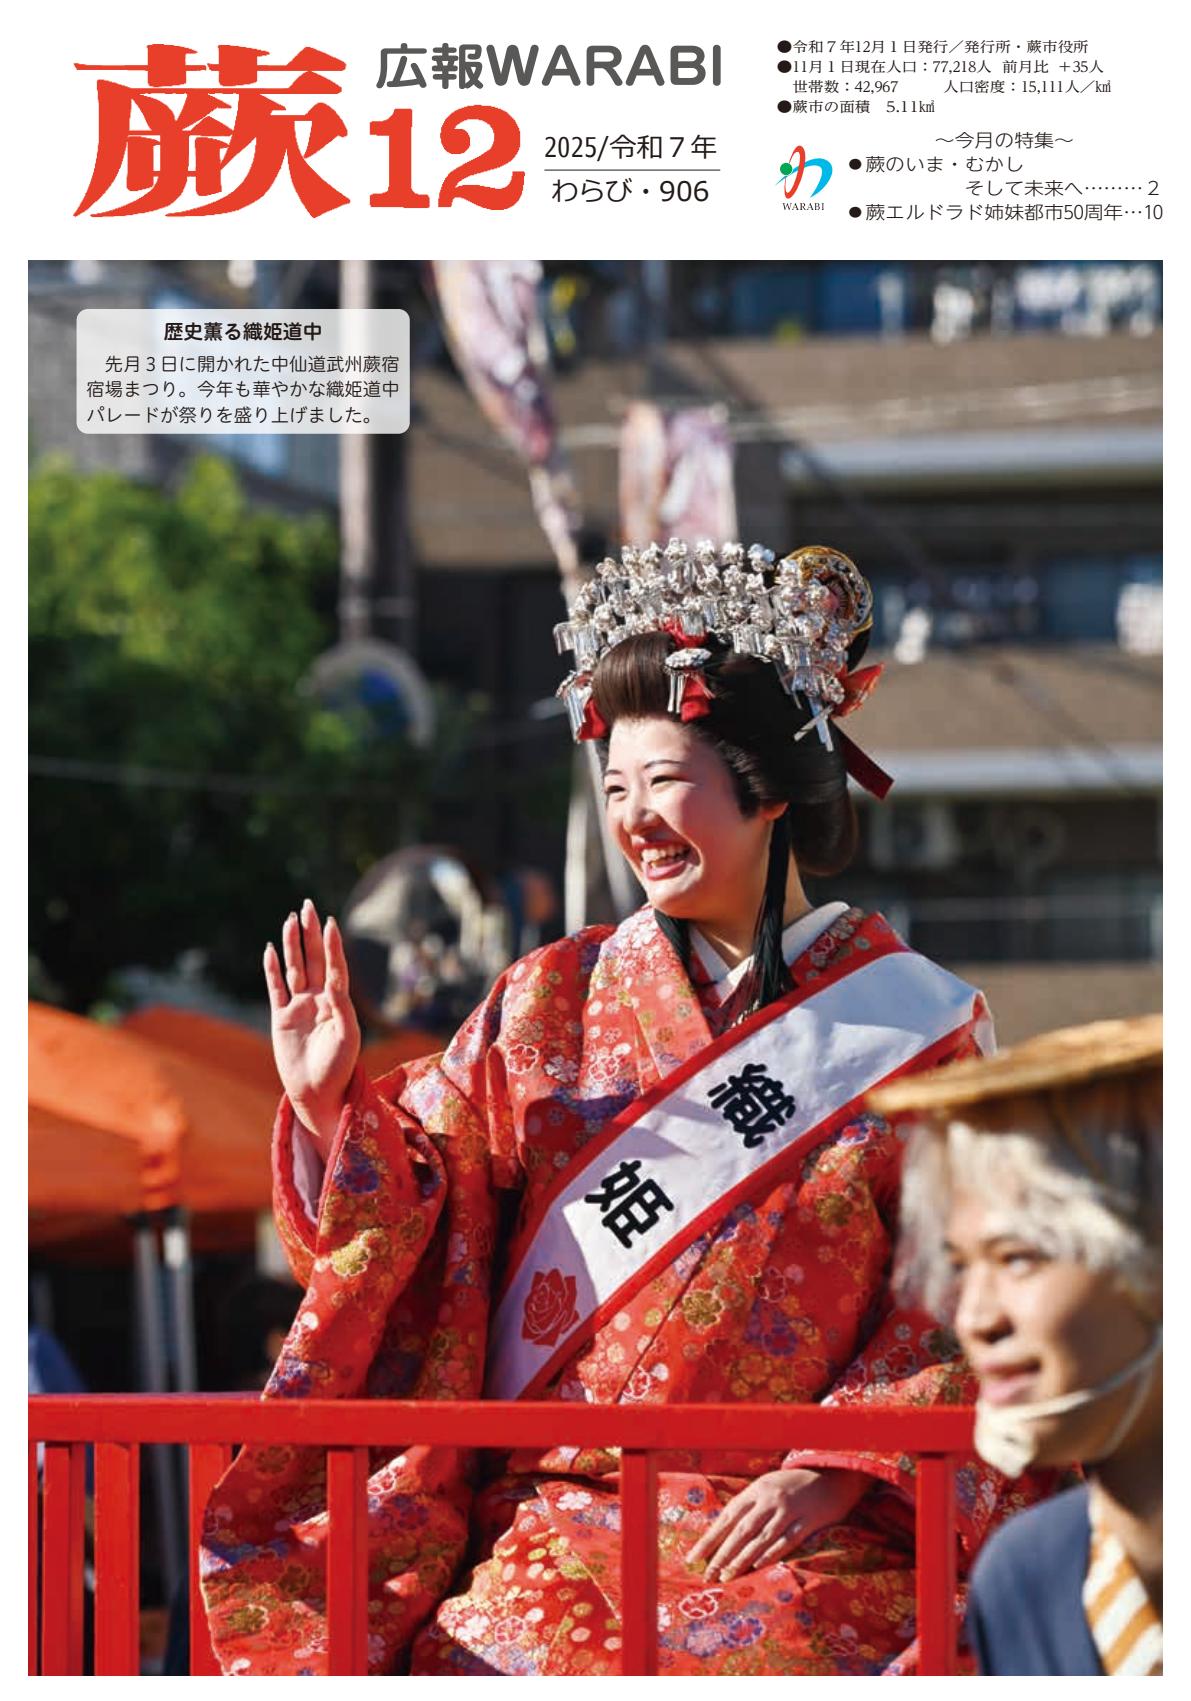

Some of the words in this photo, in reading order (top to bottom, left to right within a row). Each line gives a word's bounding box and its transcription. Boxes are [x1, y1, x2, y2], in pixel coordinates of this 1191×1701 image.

[375, 42, 722, 90] 広報WARABI
[1002, 59, 1049, 74] 前月比
[792, 99, 871, 114] 蕨市の面積
[73, 43, 351, 218] 蕨
[369, 104, 526, 211] 12
[865, 155, 1023, 173] 蕨のいま・むかし
[782, 202, 825, 211] WARABI
